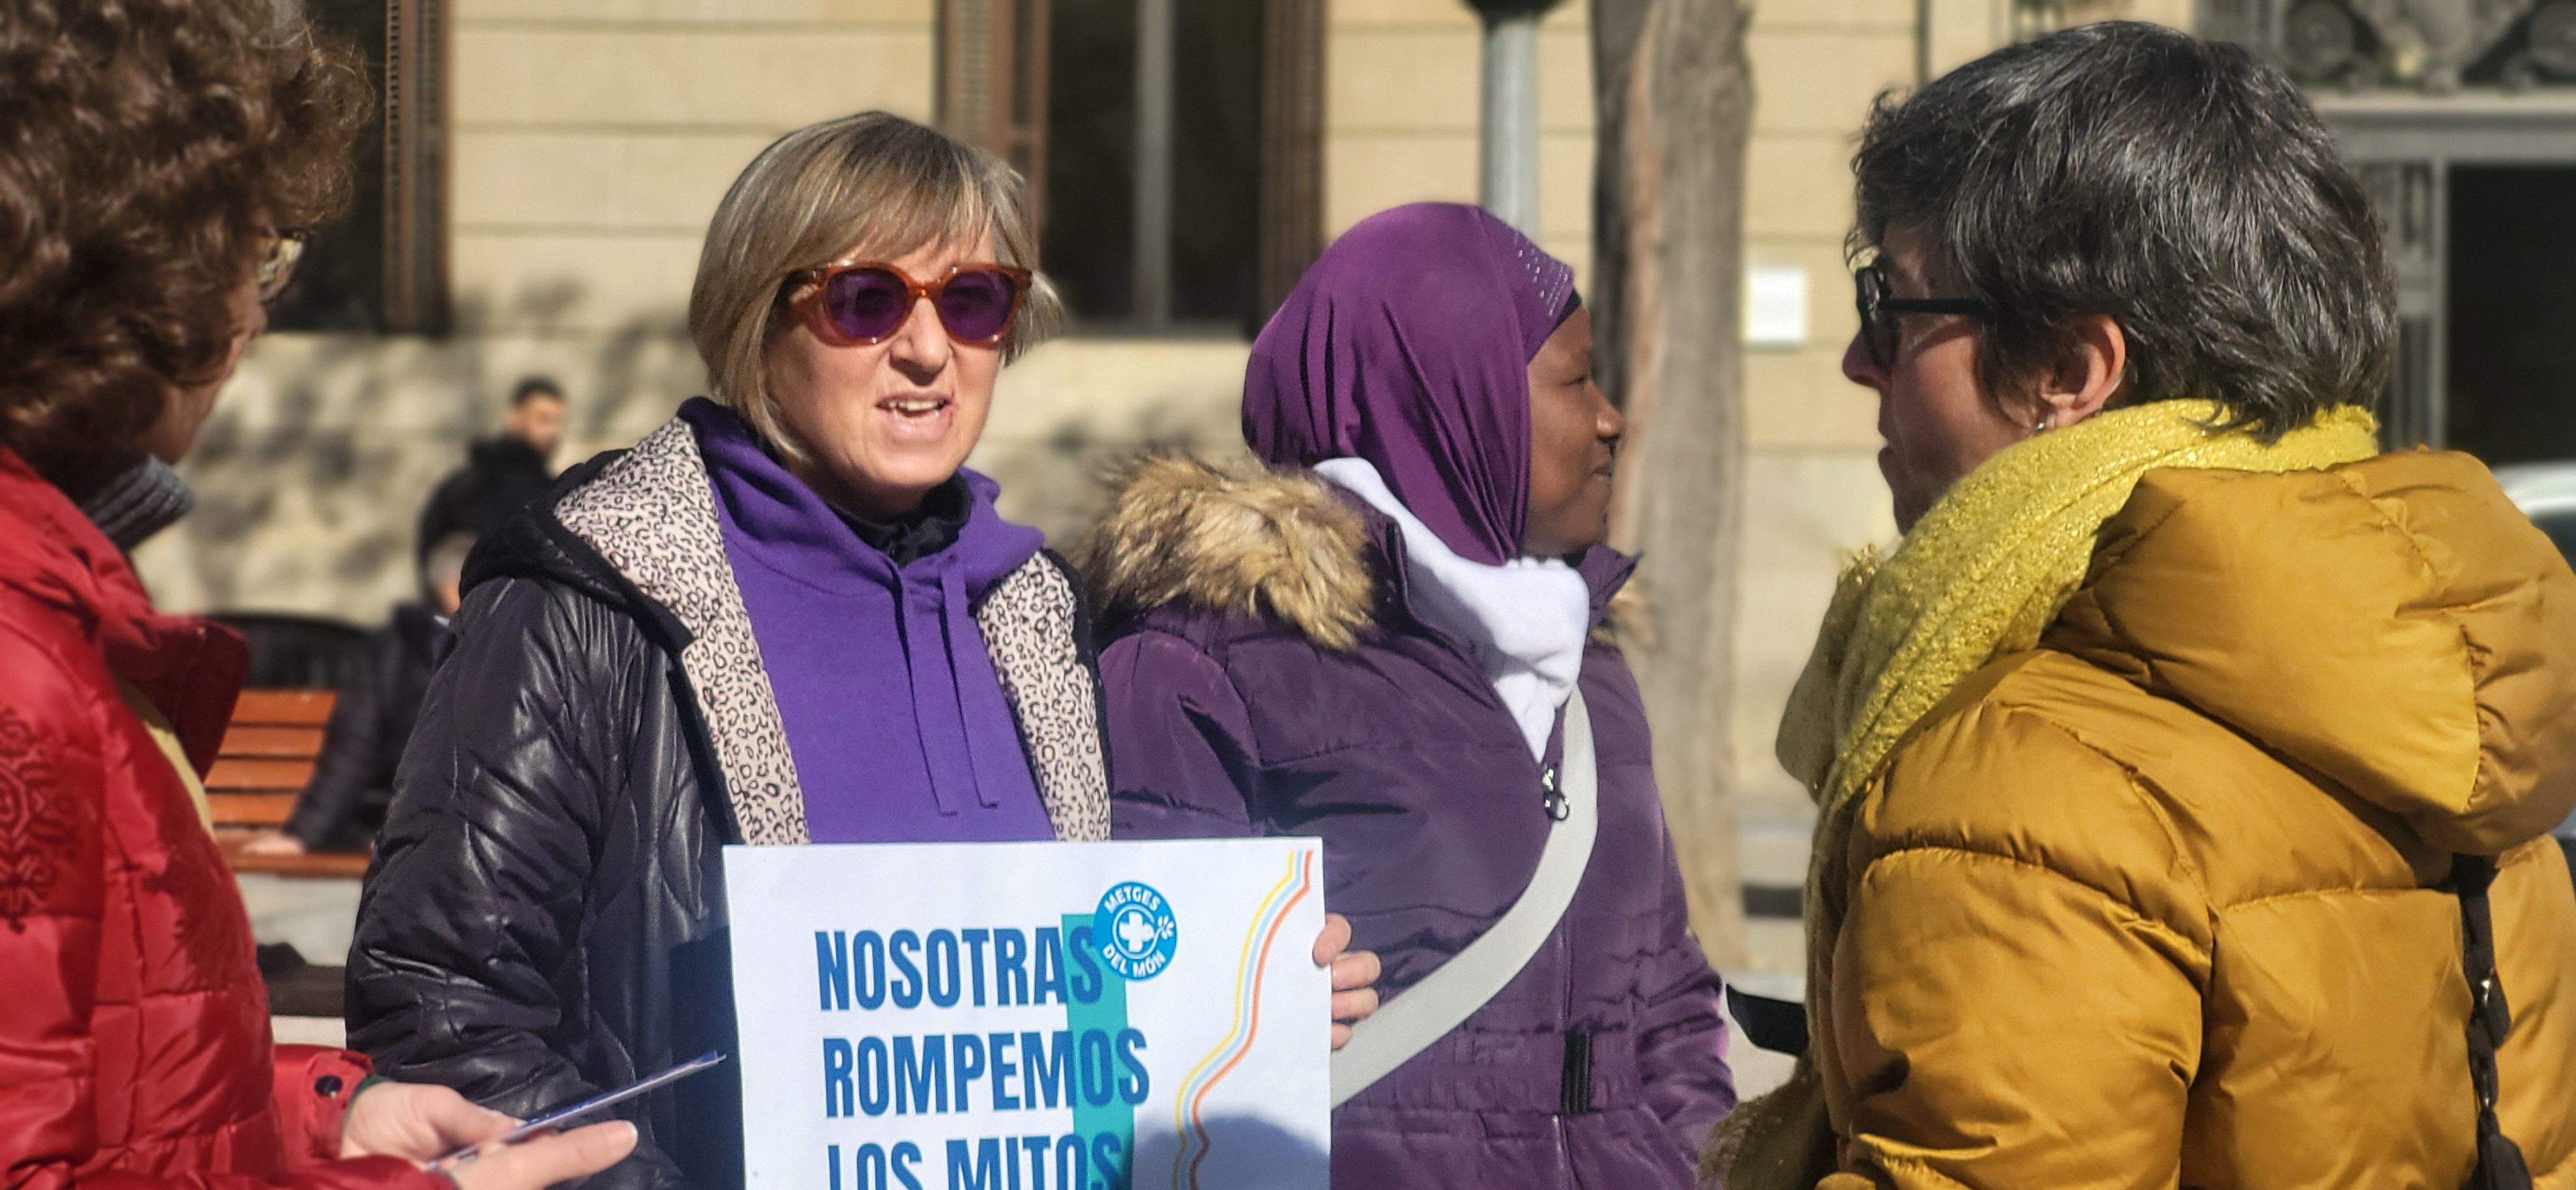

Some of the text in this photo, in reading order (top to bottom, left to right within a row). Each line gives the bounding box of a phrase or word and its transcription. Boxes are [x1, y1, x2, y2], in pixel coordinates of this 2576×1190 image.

[1104, 886, 1161, 914] METGES
[815, 927, 1103, 1011] NOSOTRAS
[1103, 943, 1127, 974] DEL
[823, 1029, 1150, 1119] ROMPEMOS
[946, 1134, 1124, 1190] MITOS
